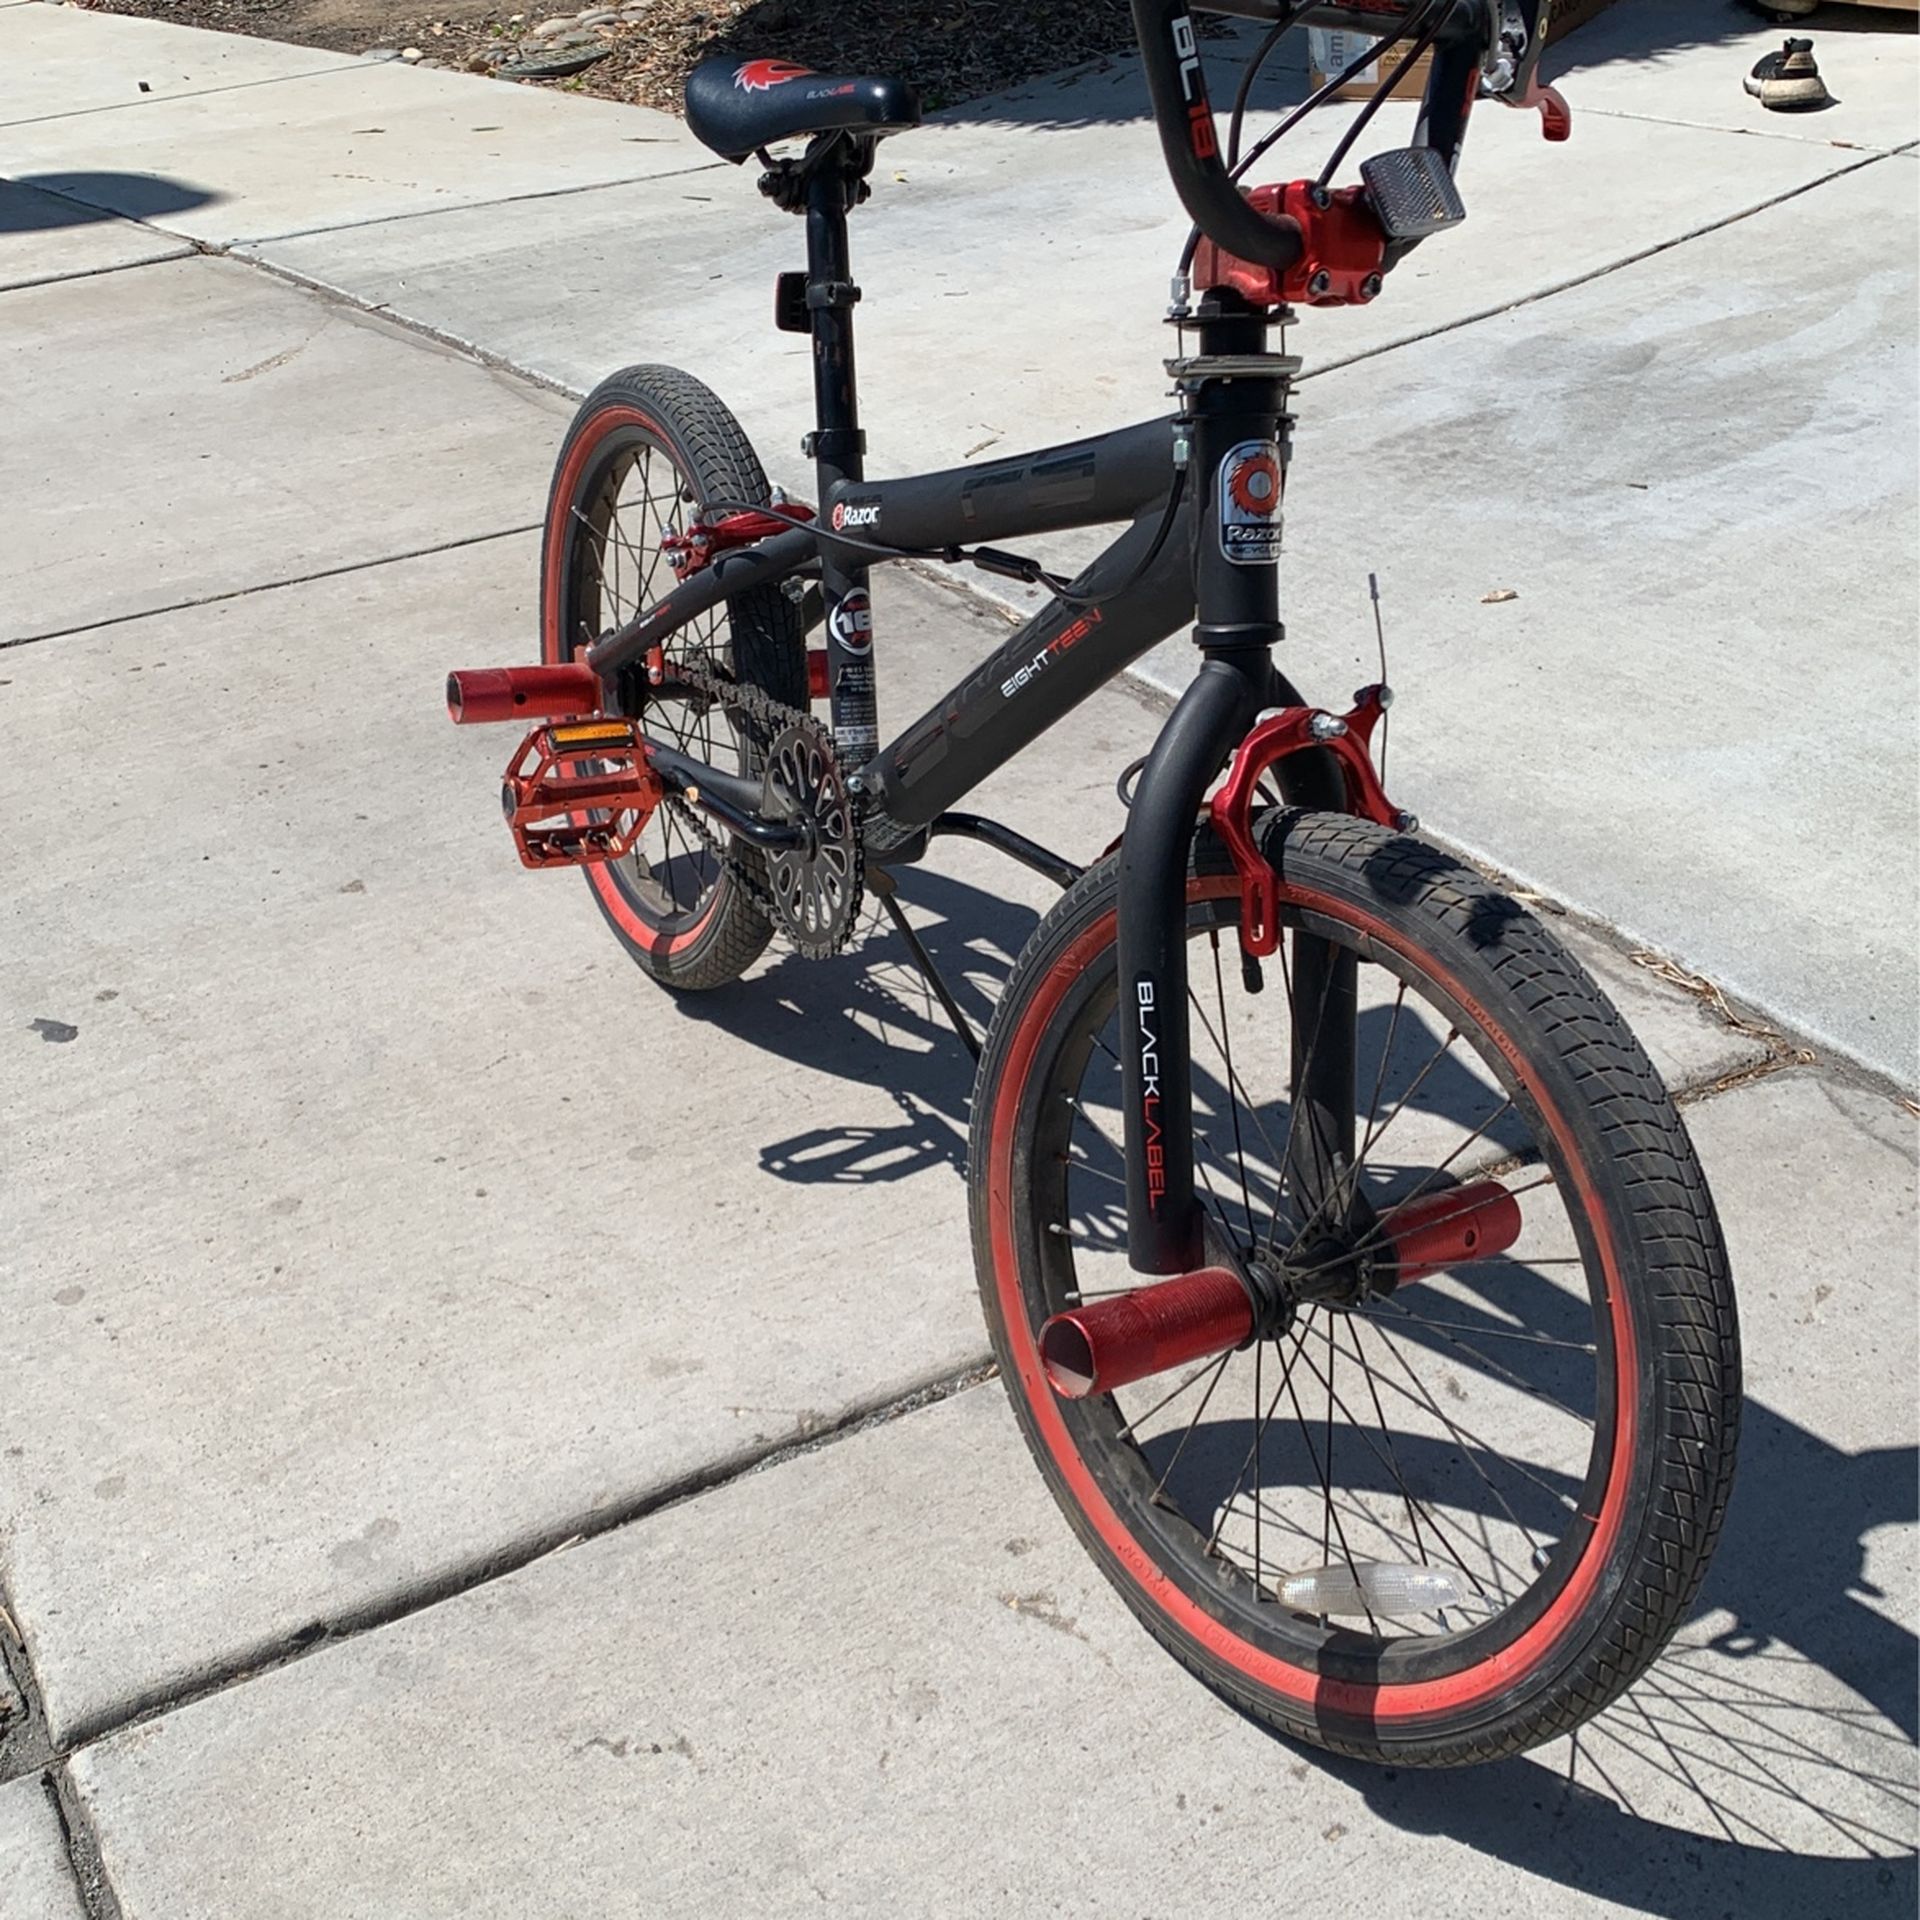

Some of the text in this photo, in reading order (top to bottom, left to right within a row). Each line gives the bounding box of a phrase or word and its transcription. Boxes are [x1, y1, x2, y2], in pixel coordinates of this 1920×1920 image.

[1330, 31, 1344, 67] am
[843, 506, 880, 526] Razor
[1137, 981, 1165, 1210] BLACKLABEL
